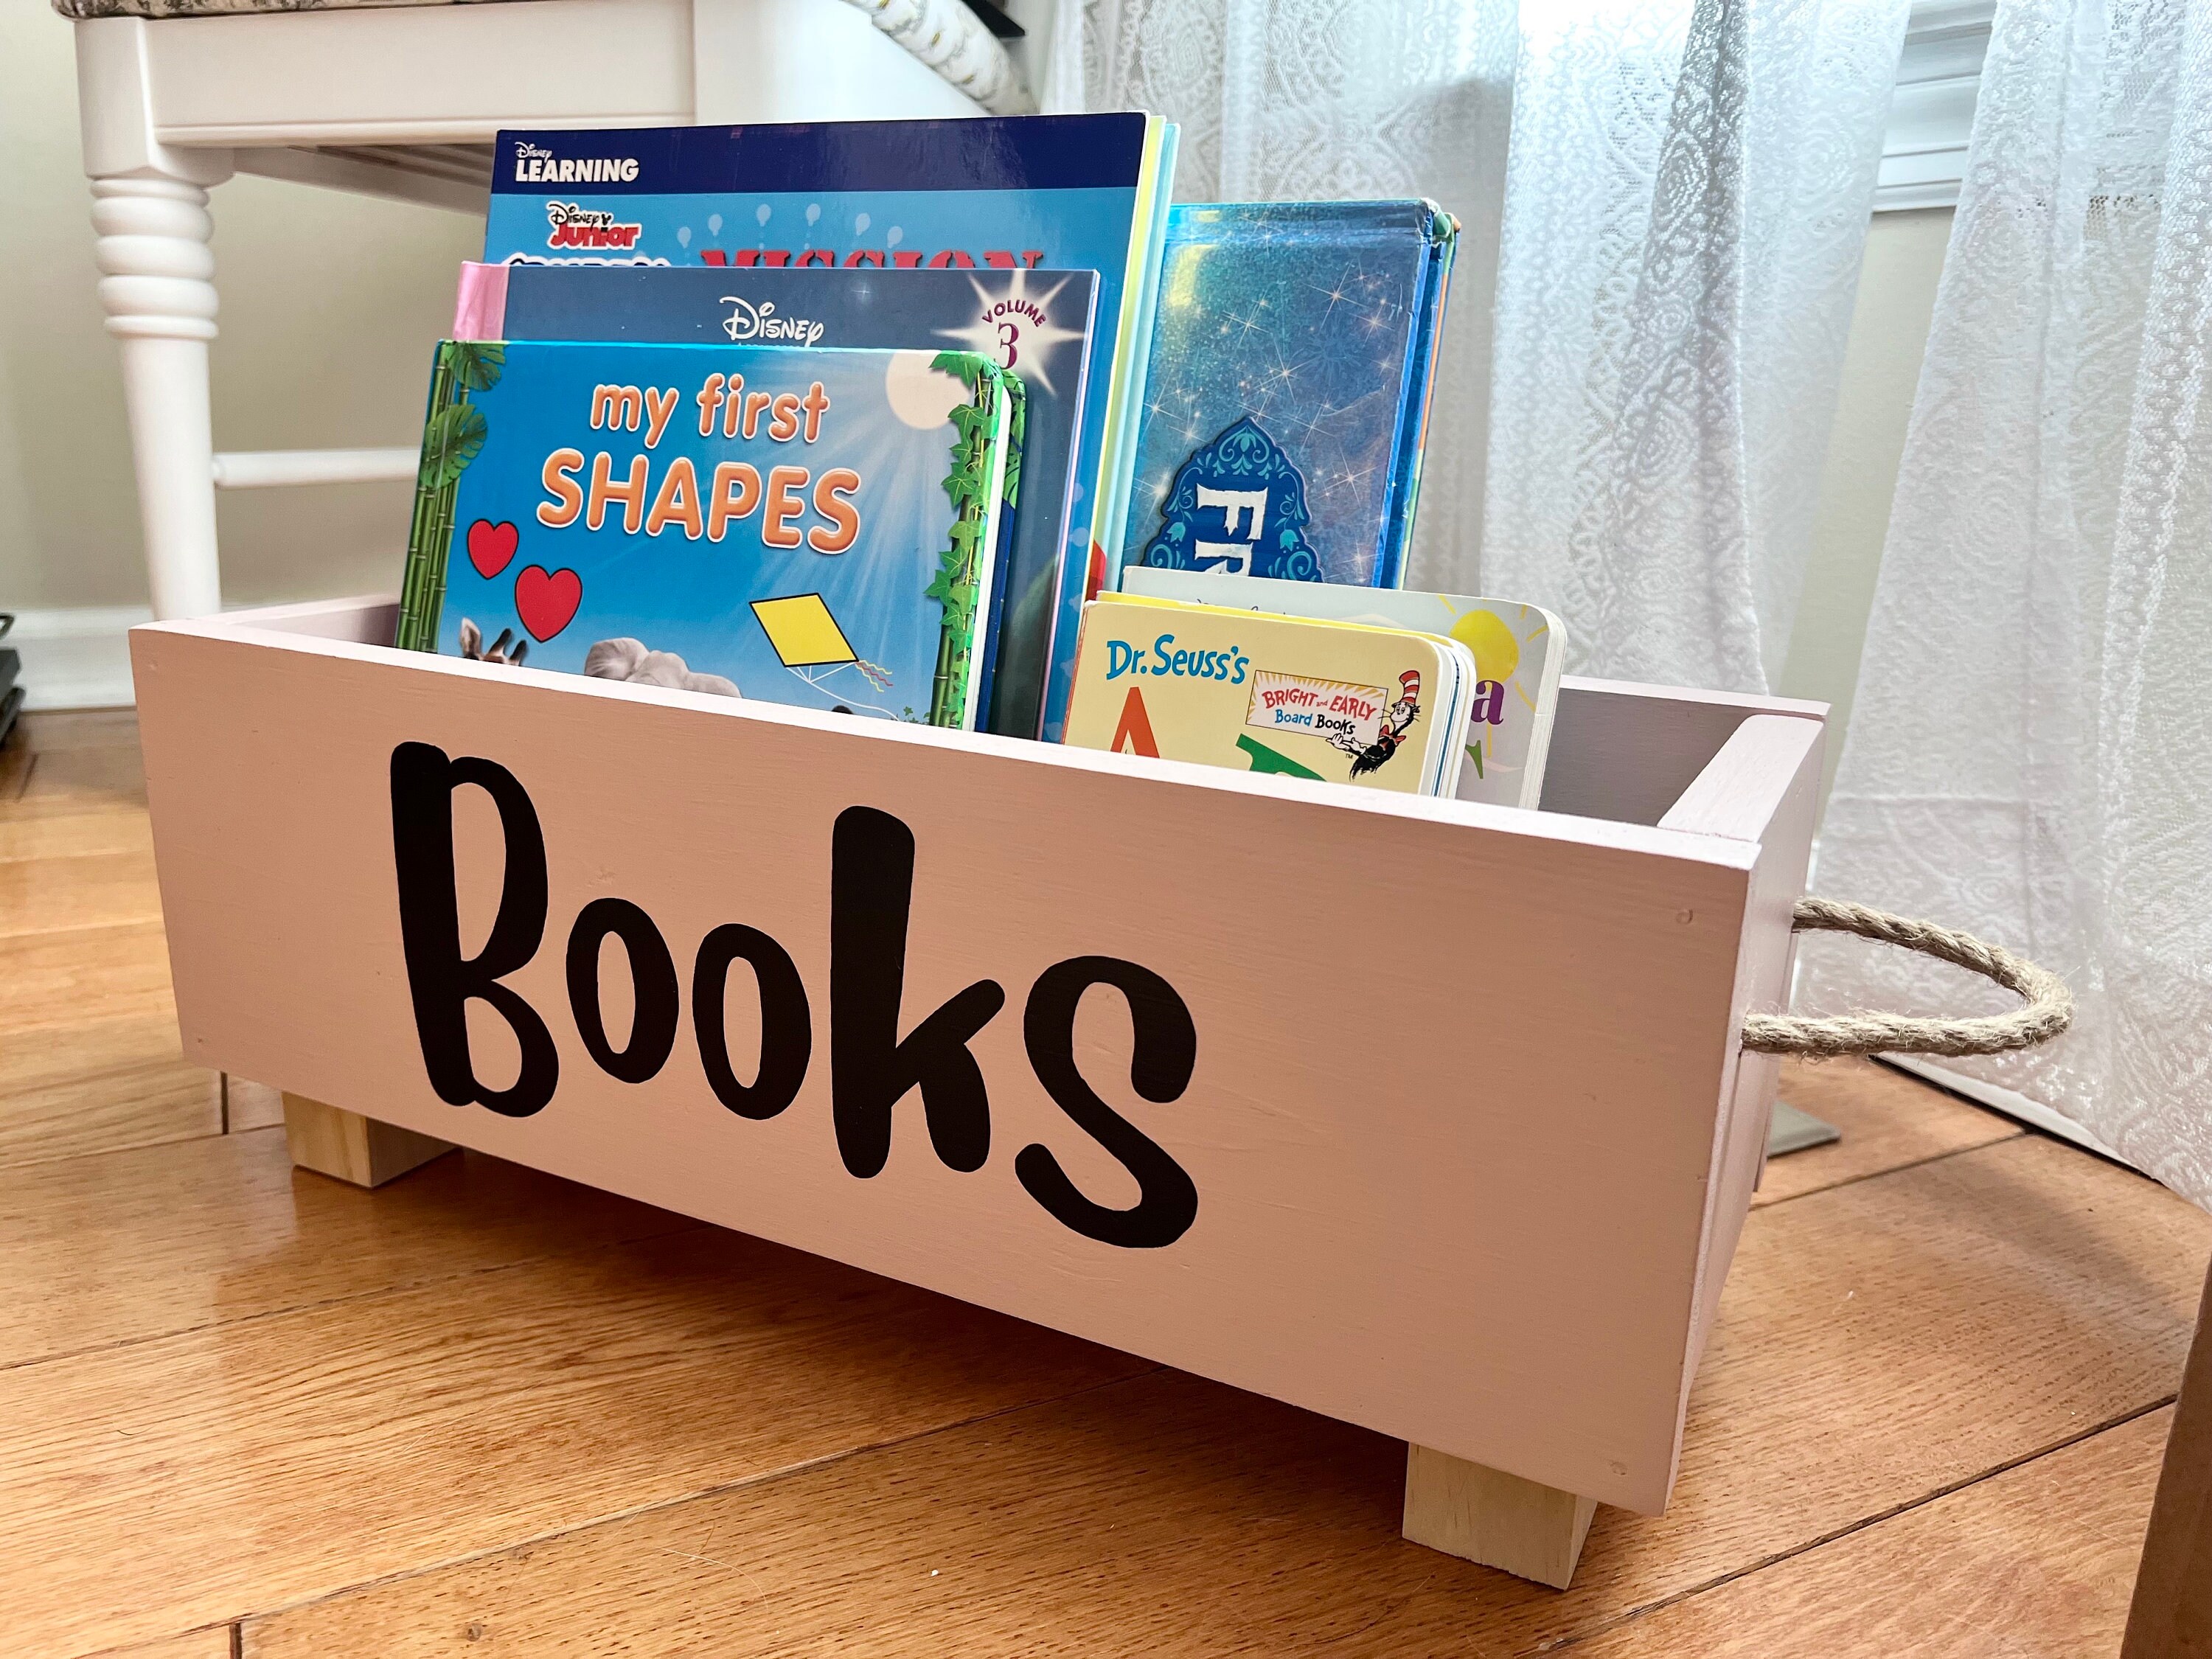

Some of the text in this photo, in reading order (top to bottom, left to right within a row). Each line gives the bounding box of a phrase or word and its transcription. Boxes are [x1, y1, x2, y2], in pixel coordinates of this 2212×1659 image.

[515, 142, 553, 164] Disney
[515, 158, 640, 183] LEARNING
[548, 204, 600, 229] Disney
[550, 223, 639, 248] Junior
[719, 296, 824, 347] Disney
[981, 299, 1047, 328] VOLUME
[993, 321, 1020, 370] 3
[589, 372, 830, 449] my first
[535, 447, 860, 556] SHAPES
[1106, 633, 1251, 685] Dr. Seuss's
[1261, 687, 1378, 722] BRIGHT and EARLY
[1274, 709, 1356, 736] Board Books
[389, 740, 1200, 1250] Books
